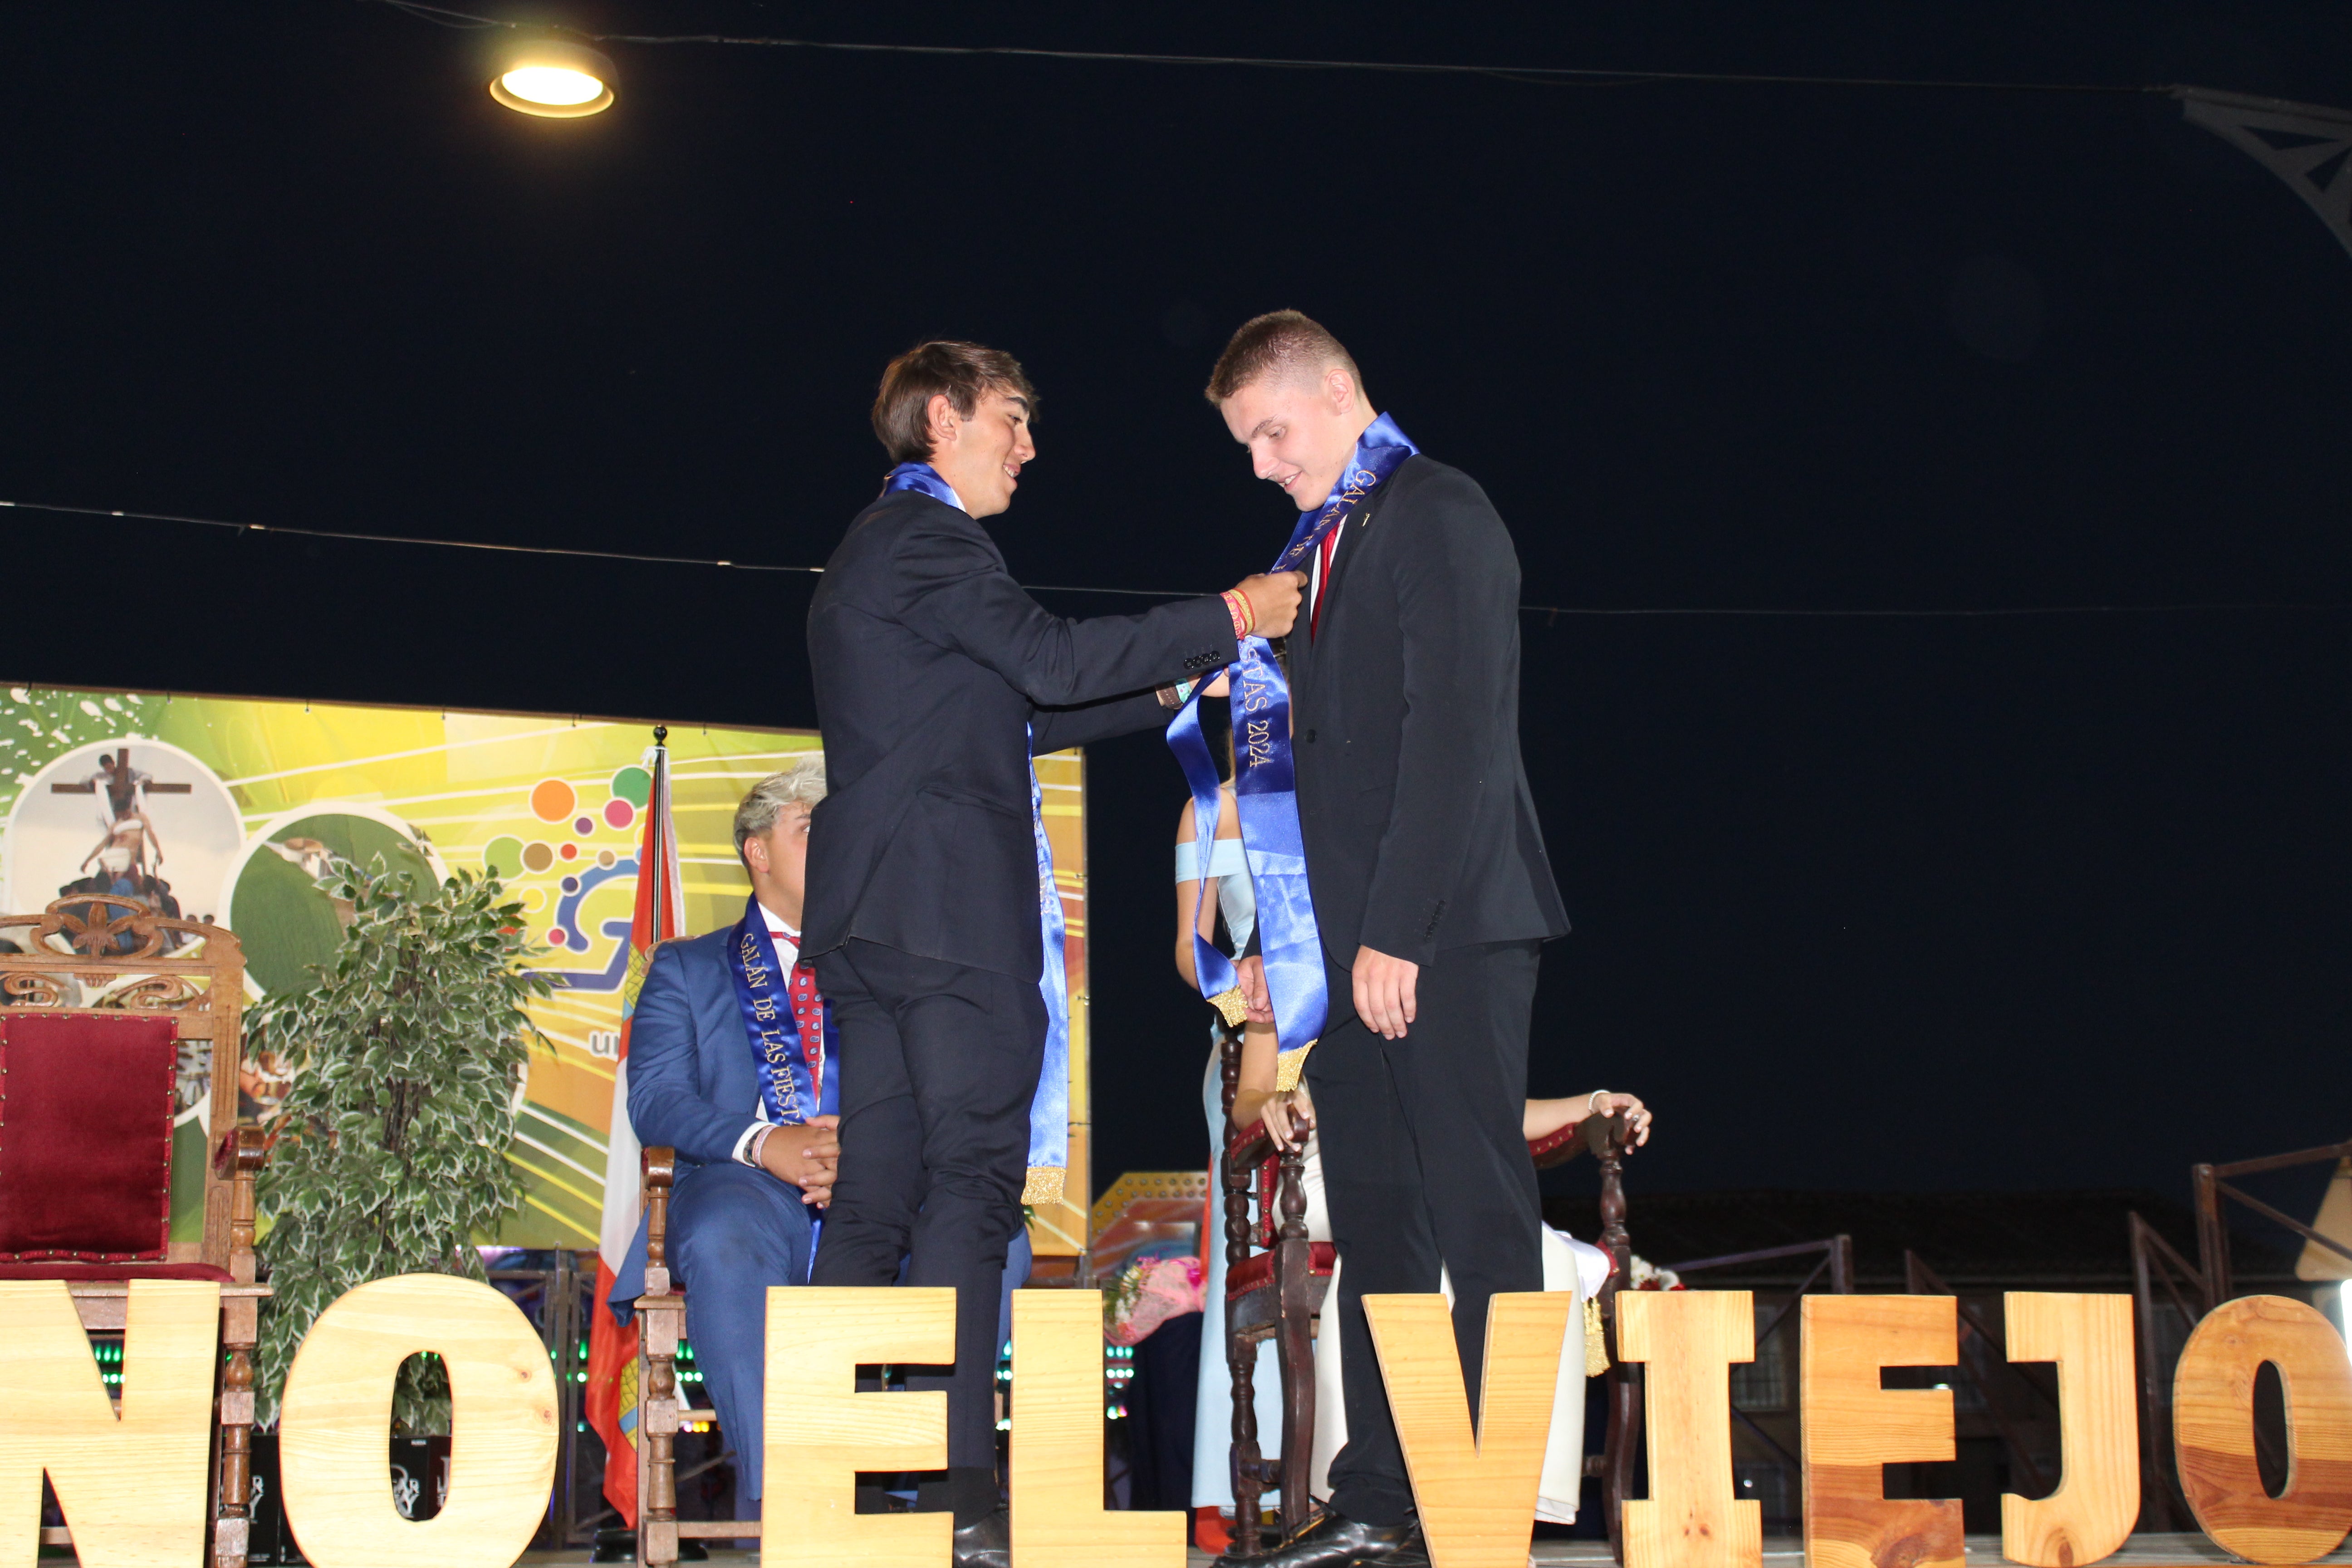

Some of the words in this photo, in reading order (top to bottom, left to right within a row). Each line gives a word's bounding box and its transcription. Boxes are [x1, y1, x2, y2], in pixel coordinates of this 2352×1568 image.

[1248, 720, 1271, 767] 2024
[753, 997, 776, 1022] DE
[761, 1029, 786, 1063] LAS
[760, 1285, 1187, 1568] EL
[1361, 1290, 2352, 1568] VIEJO
